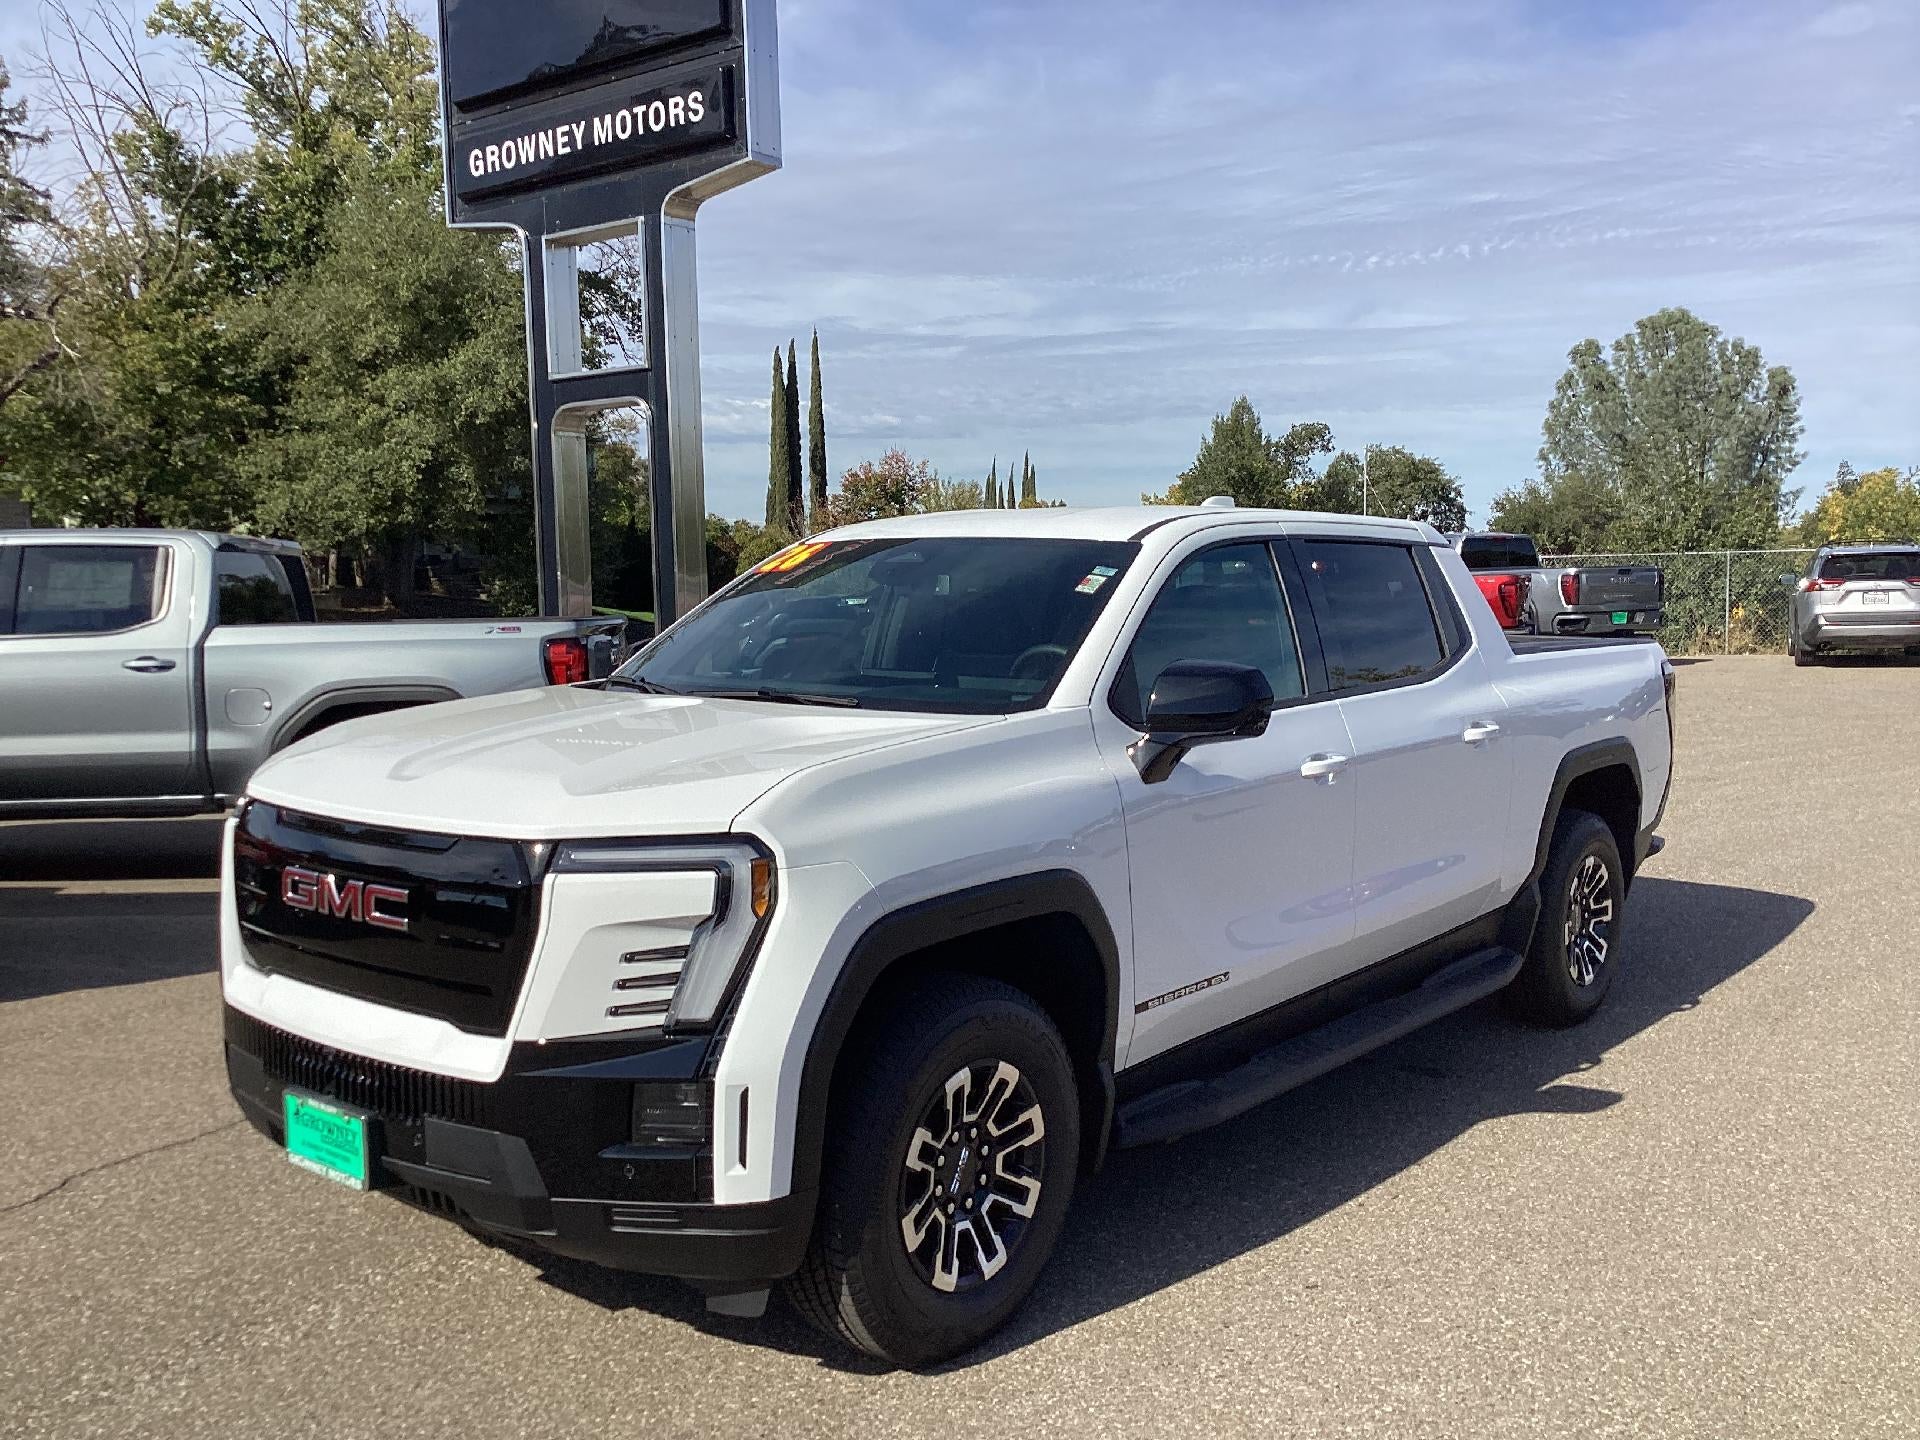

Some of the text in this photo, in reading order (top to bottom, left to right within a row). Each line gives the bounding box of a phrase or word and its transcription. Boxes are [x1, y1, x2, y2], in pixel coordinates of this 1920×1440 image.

[469, 90, 705, 177] GROWNEY MOTORS
[281, 865, 409, 931] GMC
[1147, 973, 1230, 1010] SIERRA EV
